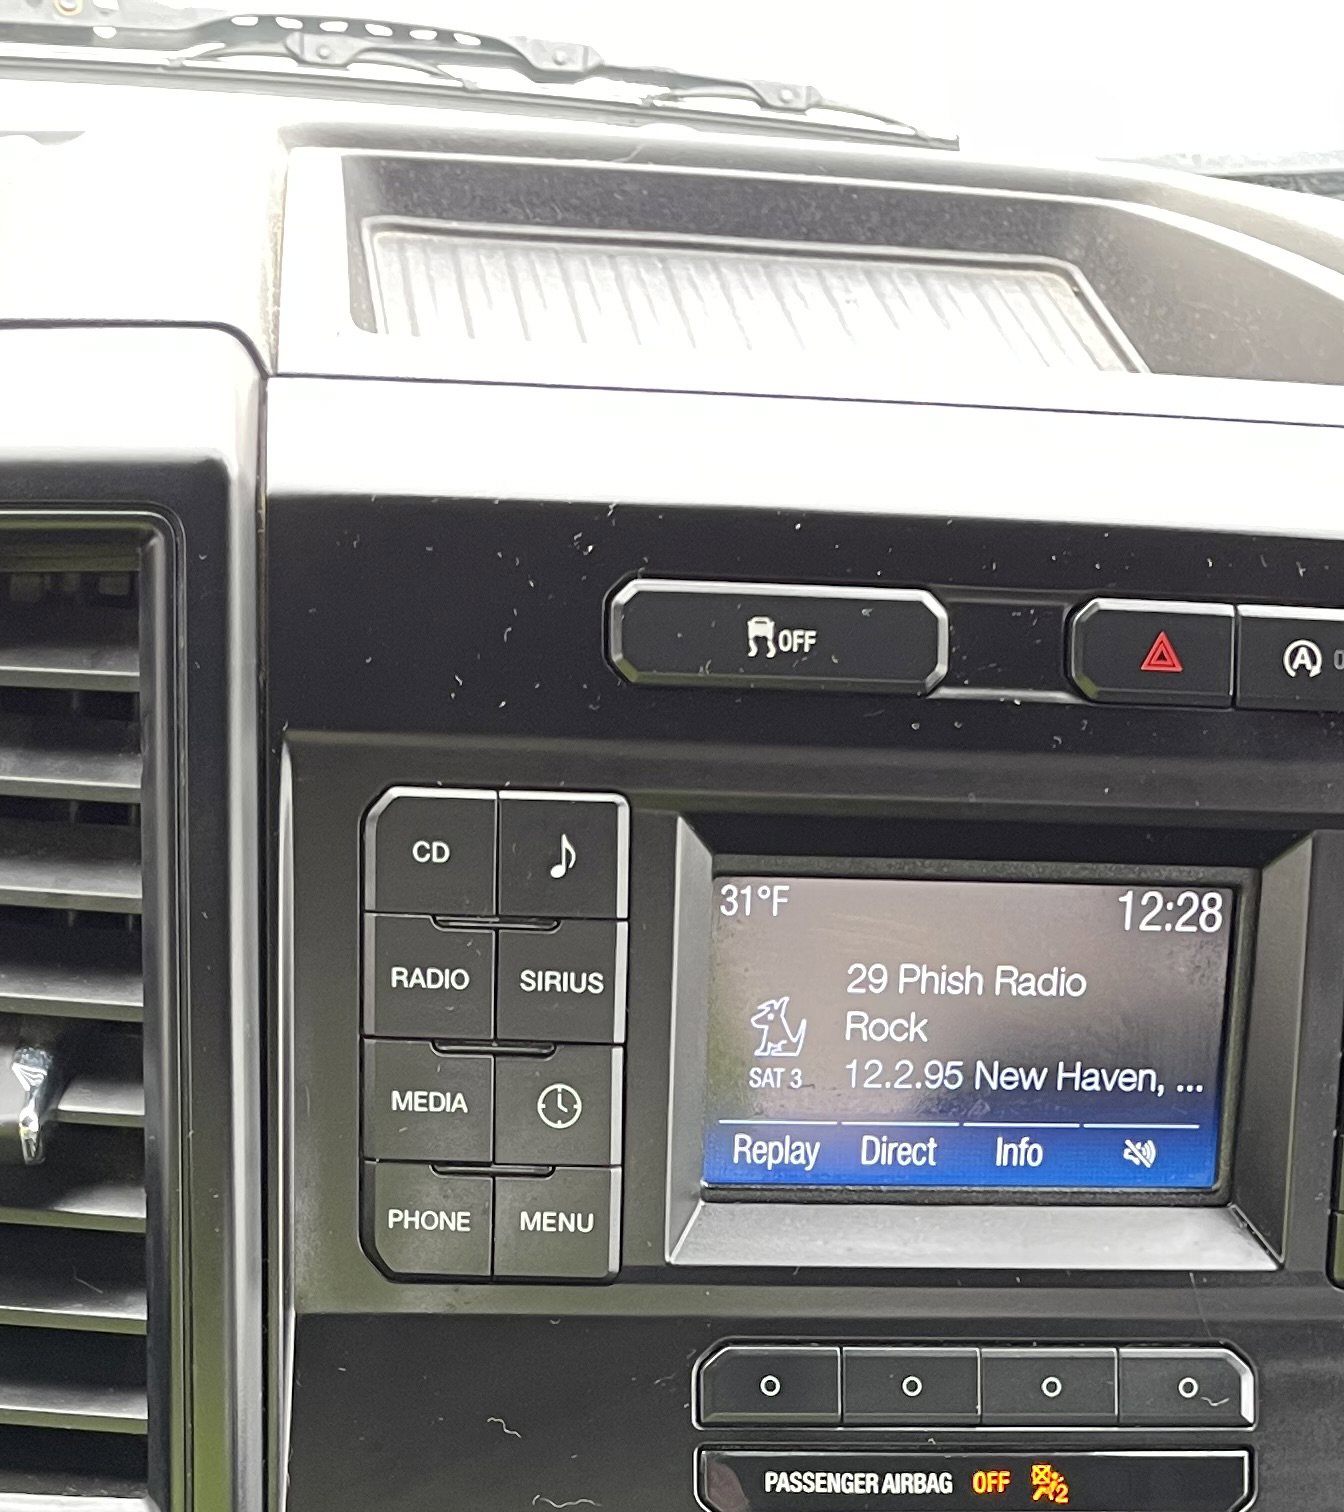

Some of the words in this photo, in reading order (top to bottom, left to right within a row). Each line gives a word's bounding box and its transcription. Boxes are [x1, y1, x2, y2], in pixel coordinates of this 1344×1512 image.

[778, 629, 817, 653] OFF
[412, 840, 450, 863] CD
[1118, 890, 1223, 933] 12:28
[391, 966, 470, 990] RADIO
[519, 969, 604, 994] SIRIUS
[846, 963, 888, 994] 29
[898, 963, 984, 996] Phish
[994, 965, 1087, 997] Radio
[845, 1010, 928, 1043] Rock
[748, 1067, 786, 1089] SAT
[789, 1067, 803, 1089] 3
[845, 1058, 964, 1090] 12.2.95
[974, 1059, 1049, 1091] New
[1056, 1061, 1165, 1097] Haven,
[391, 1090, 469, 1114] MEDIA
[733, 1132, 821, 1171] Replay
[860, 1134, 938, 1166] Direct
[995, 1136, 1044, 1167] Info
[388, 1208, 471, 1232] PHONE
[520, 1210, 594, 1233] MENU
[764, 1471, 879, 1495] PASSENGER
[881, 1472, 953, 1495] AIRBAG
[971, 1469, 1012, 1495] OFF
